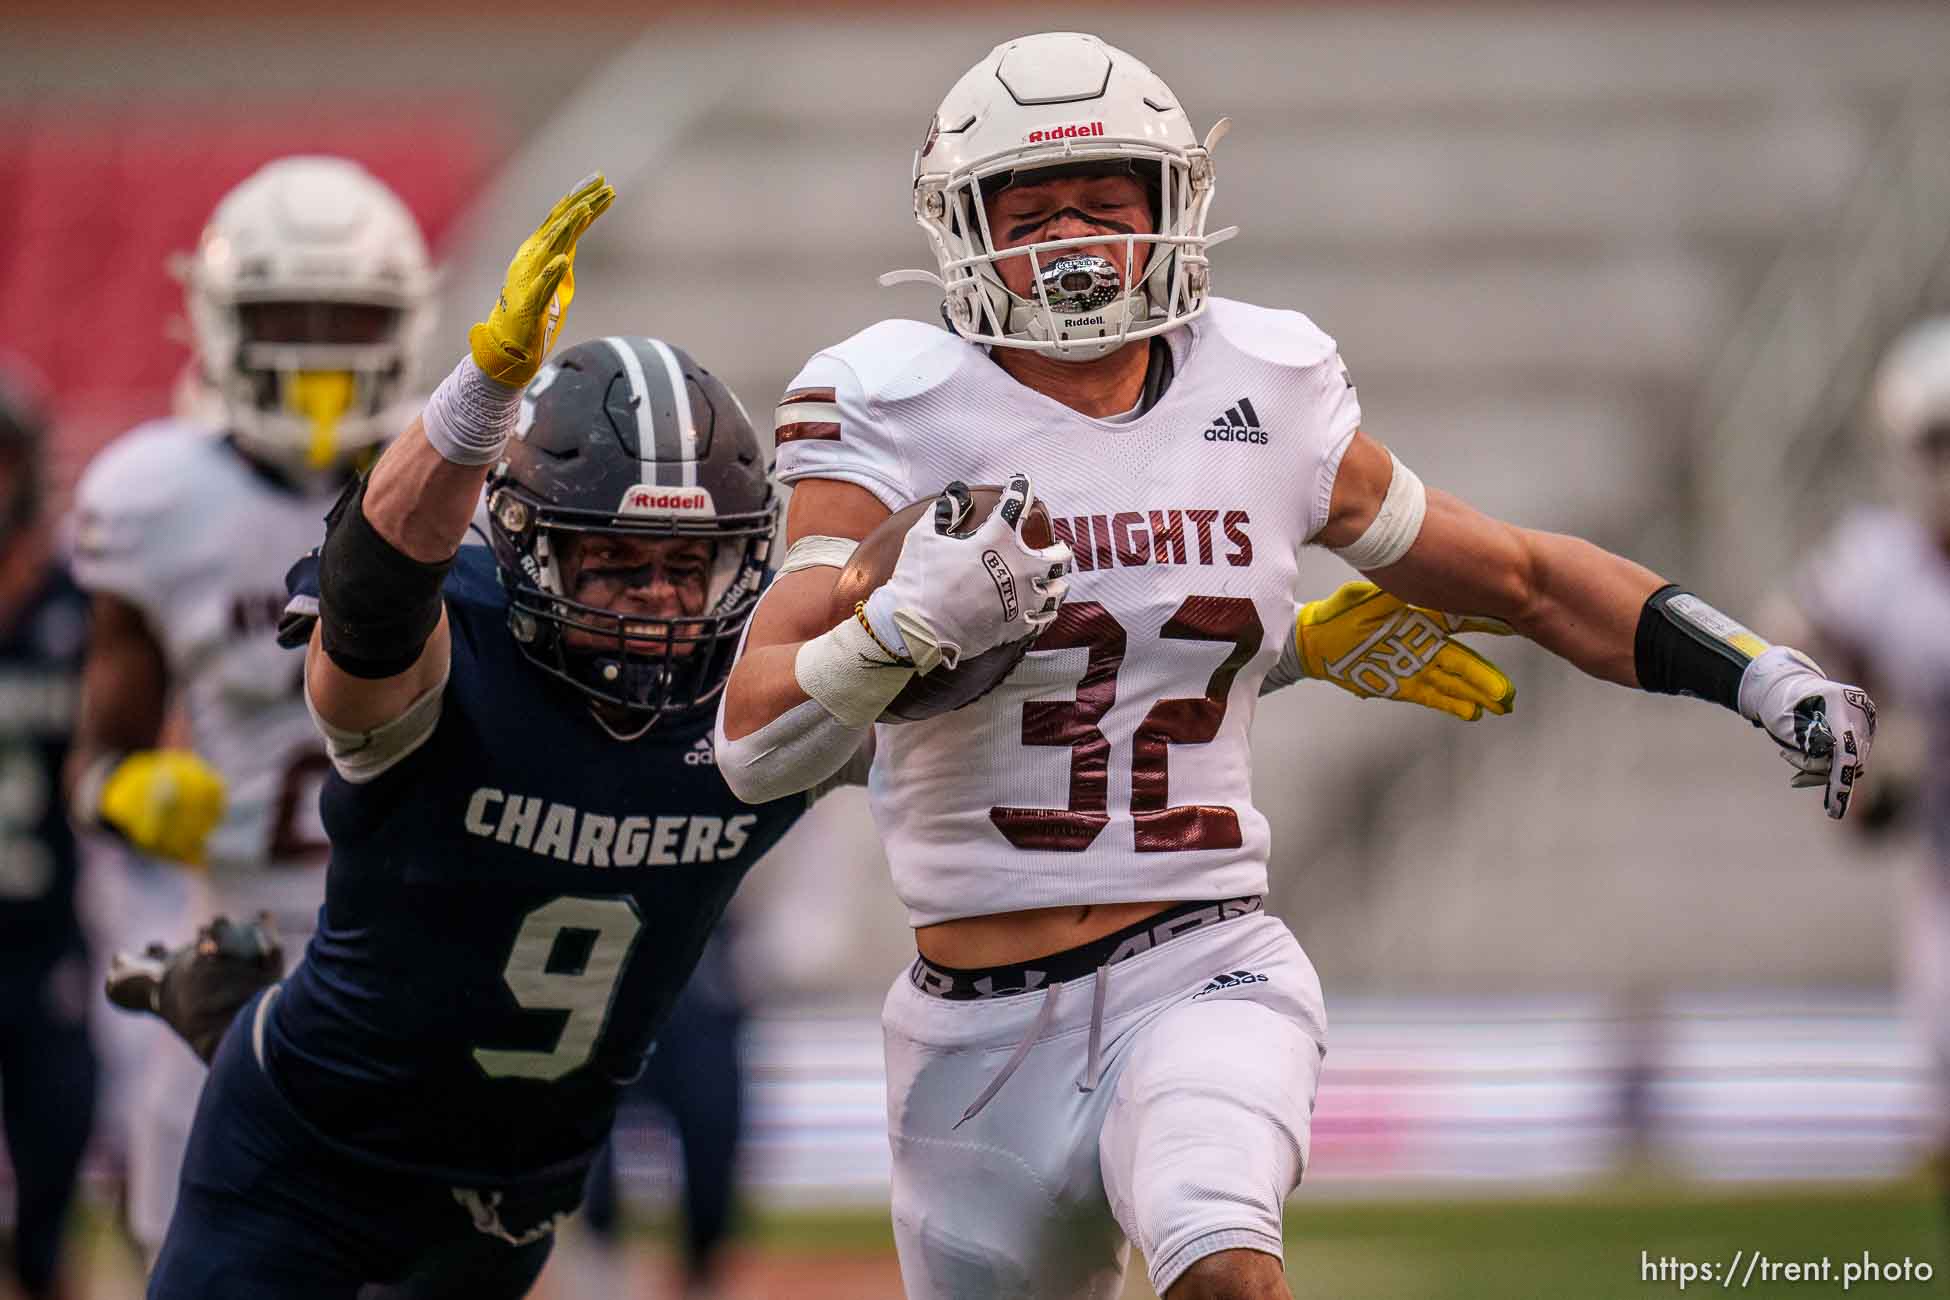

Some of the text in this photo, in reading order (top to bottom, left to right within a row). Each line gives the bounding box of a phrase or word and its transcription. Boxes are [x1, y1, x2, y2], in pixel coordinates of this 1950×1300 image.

[1028, 122, 1104, 143] Riddell
[1064, 316, 1104, 328] Riddell
[1204, 425, 1269, 446] adidas
[635, 494, 704, 509] Riddell
[1053, 510, 1252, 571] NIGHTS
[987, 555, 1016, 617] BATTLE
[989, 595, 1264, 853] 32
[464, 787, 757, 867] CHARGERS
[472, 895, 641, 1082] 9
